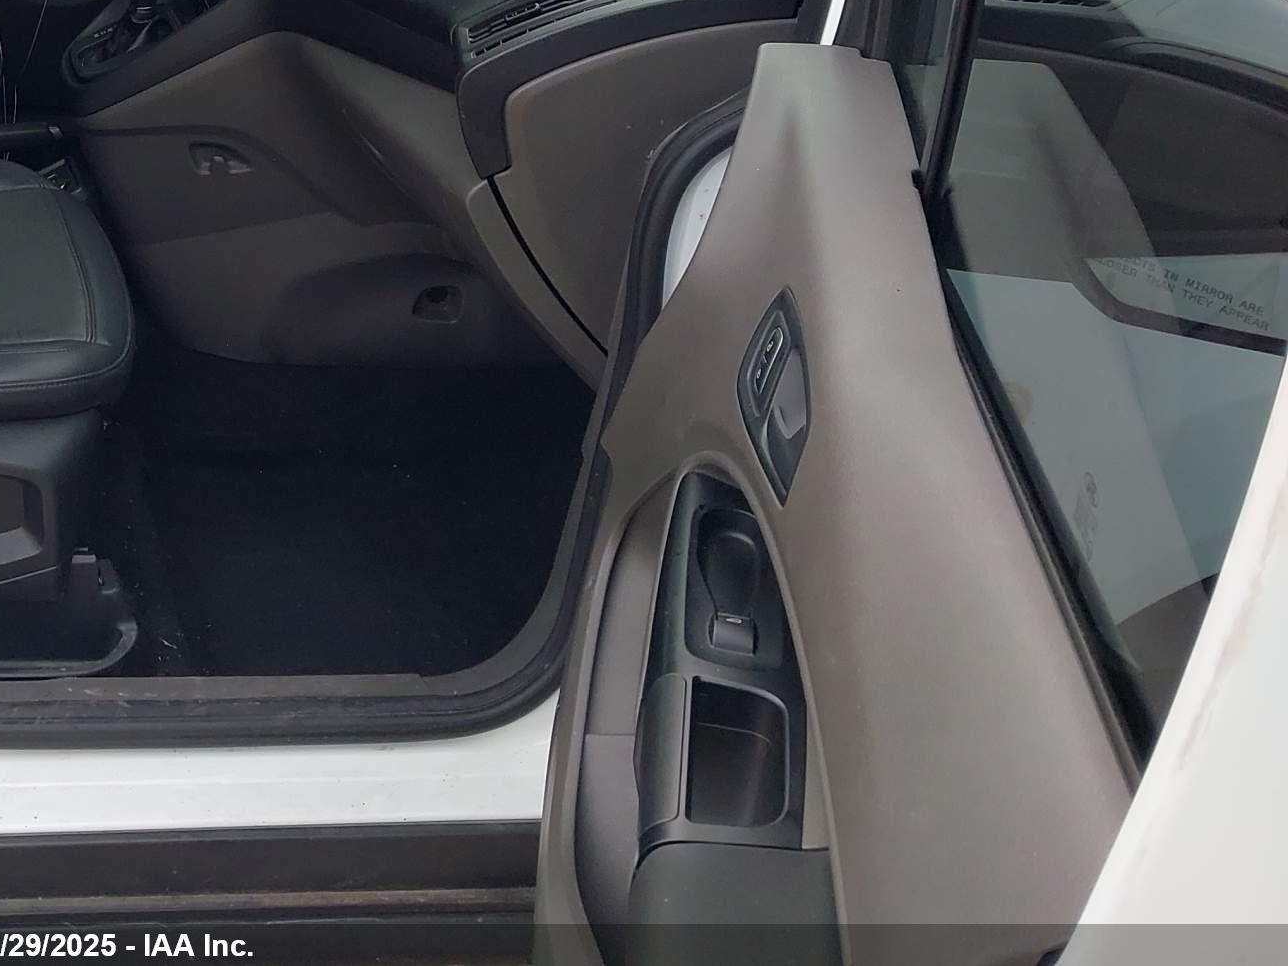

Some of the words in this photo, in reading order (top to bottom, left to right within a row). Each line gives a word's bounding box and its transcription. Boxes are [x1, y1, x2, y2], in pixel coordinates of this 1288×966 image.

[1164, 268, 1180, 283] IN
[1185, 278, 1234, 304] MIRROR
[1239, 300, 1265, 315] ARE
[1183, 289, 1214, 308] THEY
[1219, 305, 1270, 331] APPEAR
